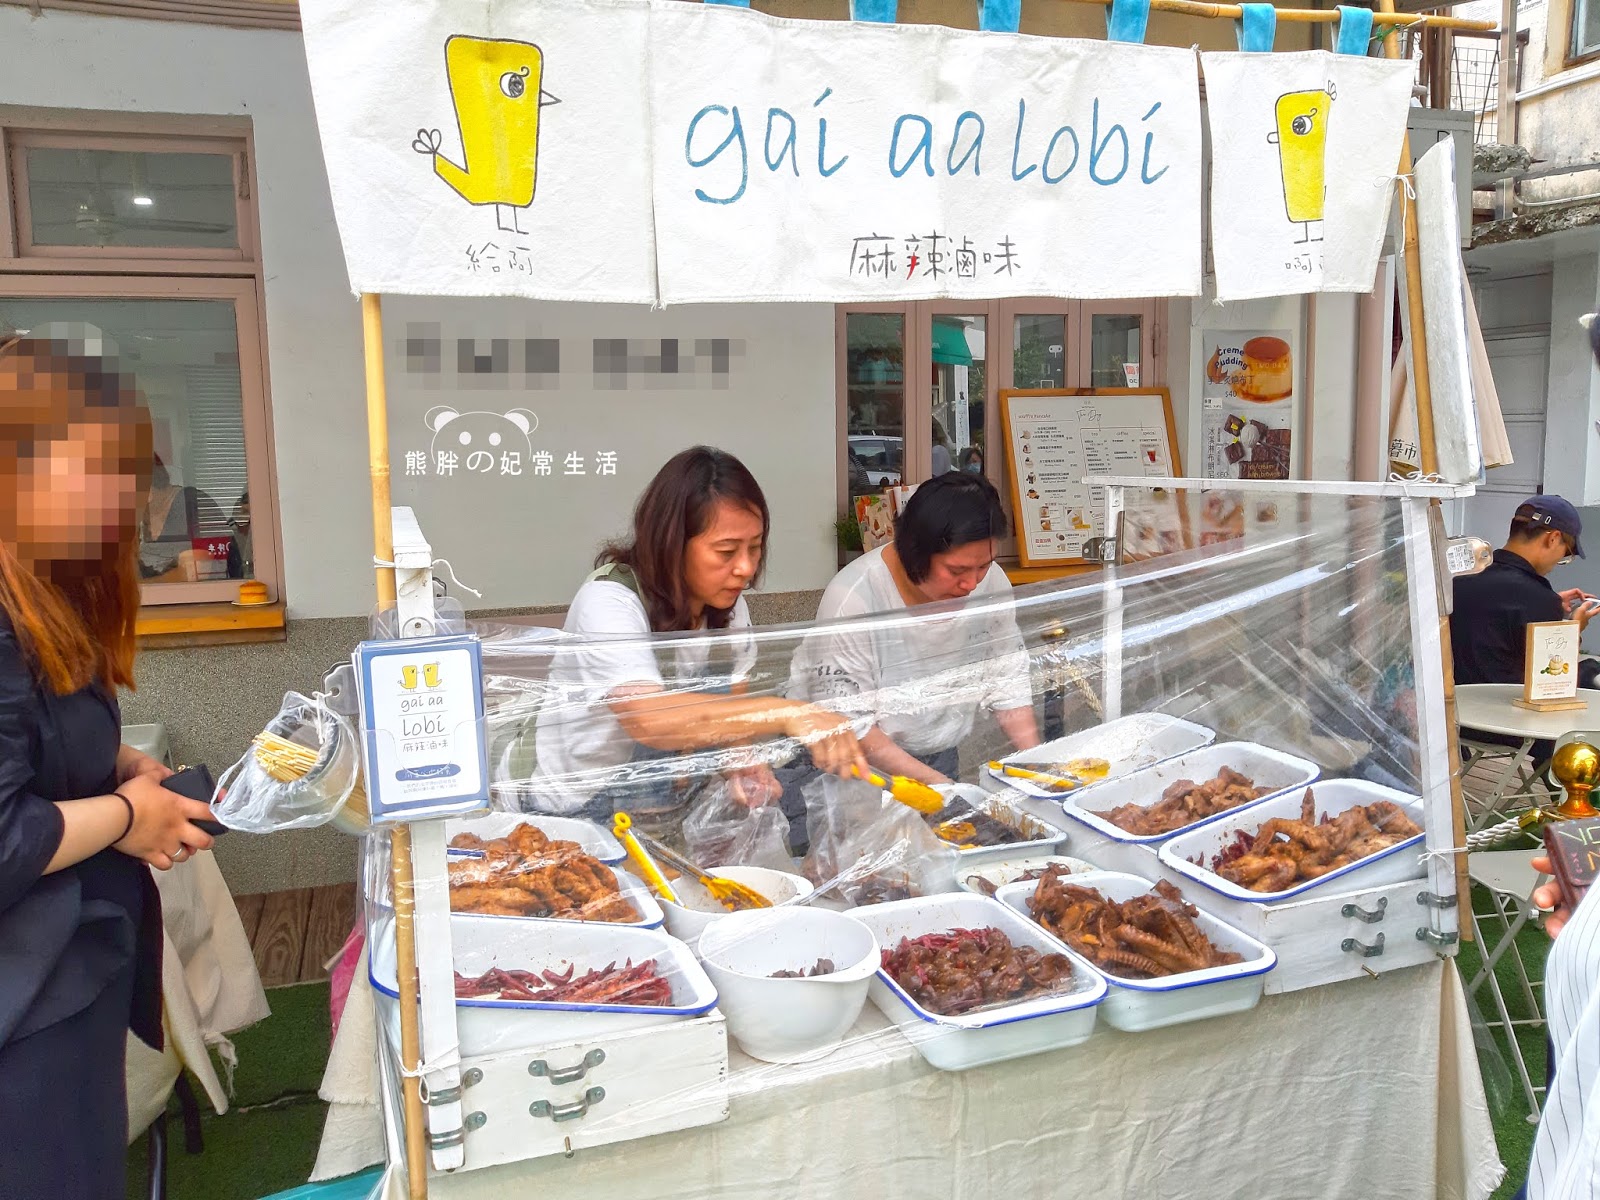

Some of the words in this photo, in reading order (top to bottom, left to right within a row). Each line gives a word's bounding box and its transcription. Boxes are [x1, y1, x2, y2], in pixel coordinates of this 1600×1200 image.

[685, 87, 849, 205] gai
[889, 111, 985, 178] aa
[1012, 97, 1170, 185] lobi
[465, 241, 533, 275] 給阿
[849, 229, 1022, 281] 麻辣滷味
[1285, 253, 1324, 273] 啊
[1217, 347, 1245, 357] Creme
[1214, 357, 1248, 370] Pudding
[401, 696, 424, 713] gai
[428, 696, 443, 706] aa
